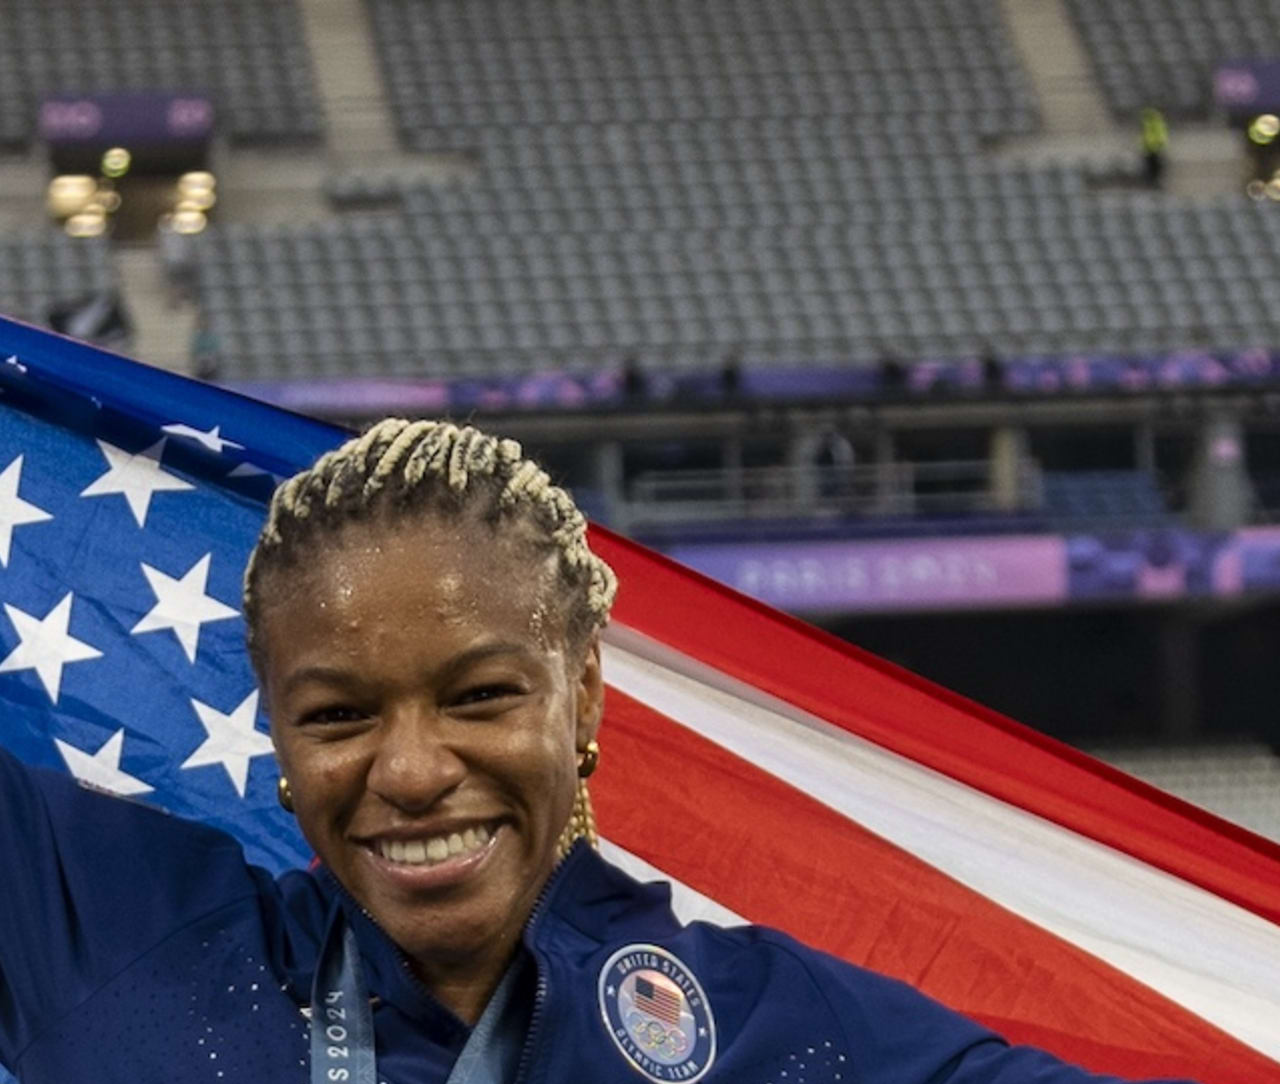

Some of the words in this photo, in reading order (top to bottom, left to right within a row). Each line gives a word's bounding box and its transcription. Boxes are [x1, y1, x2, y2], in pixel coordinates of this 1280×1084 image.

[616, 952, 659, 976] UNITED
[662, 959, 702, 1008] STATES
[325, 990, 350, 1058] 2024
[614, 1027, 663, 1078] OLYMPIC
[668, 1059, 700, 1080] TEAM
